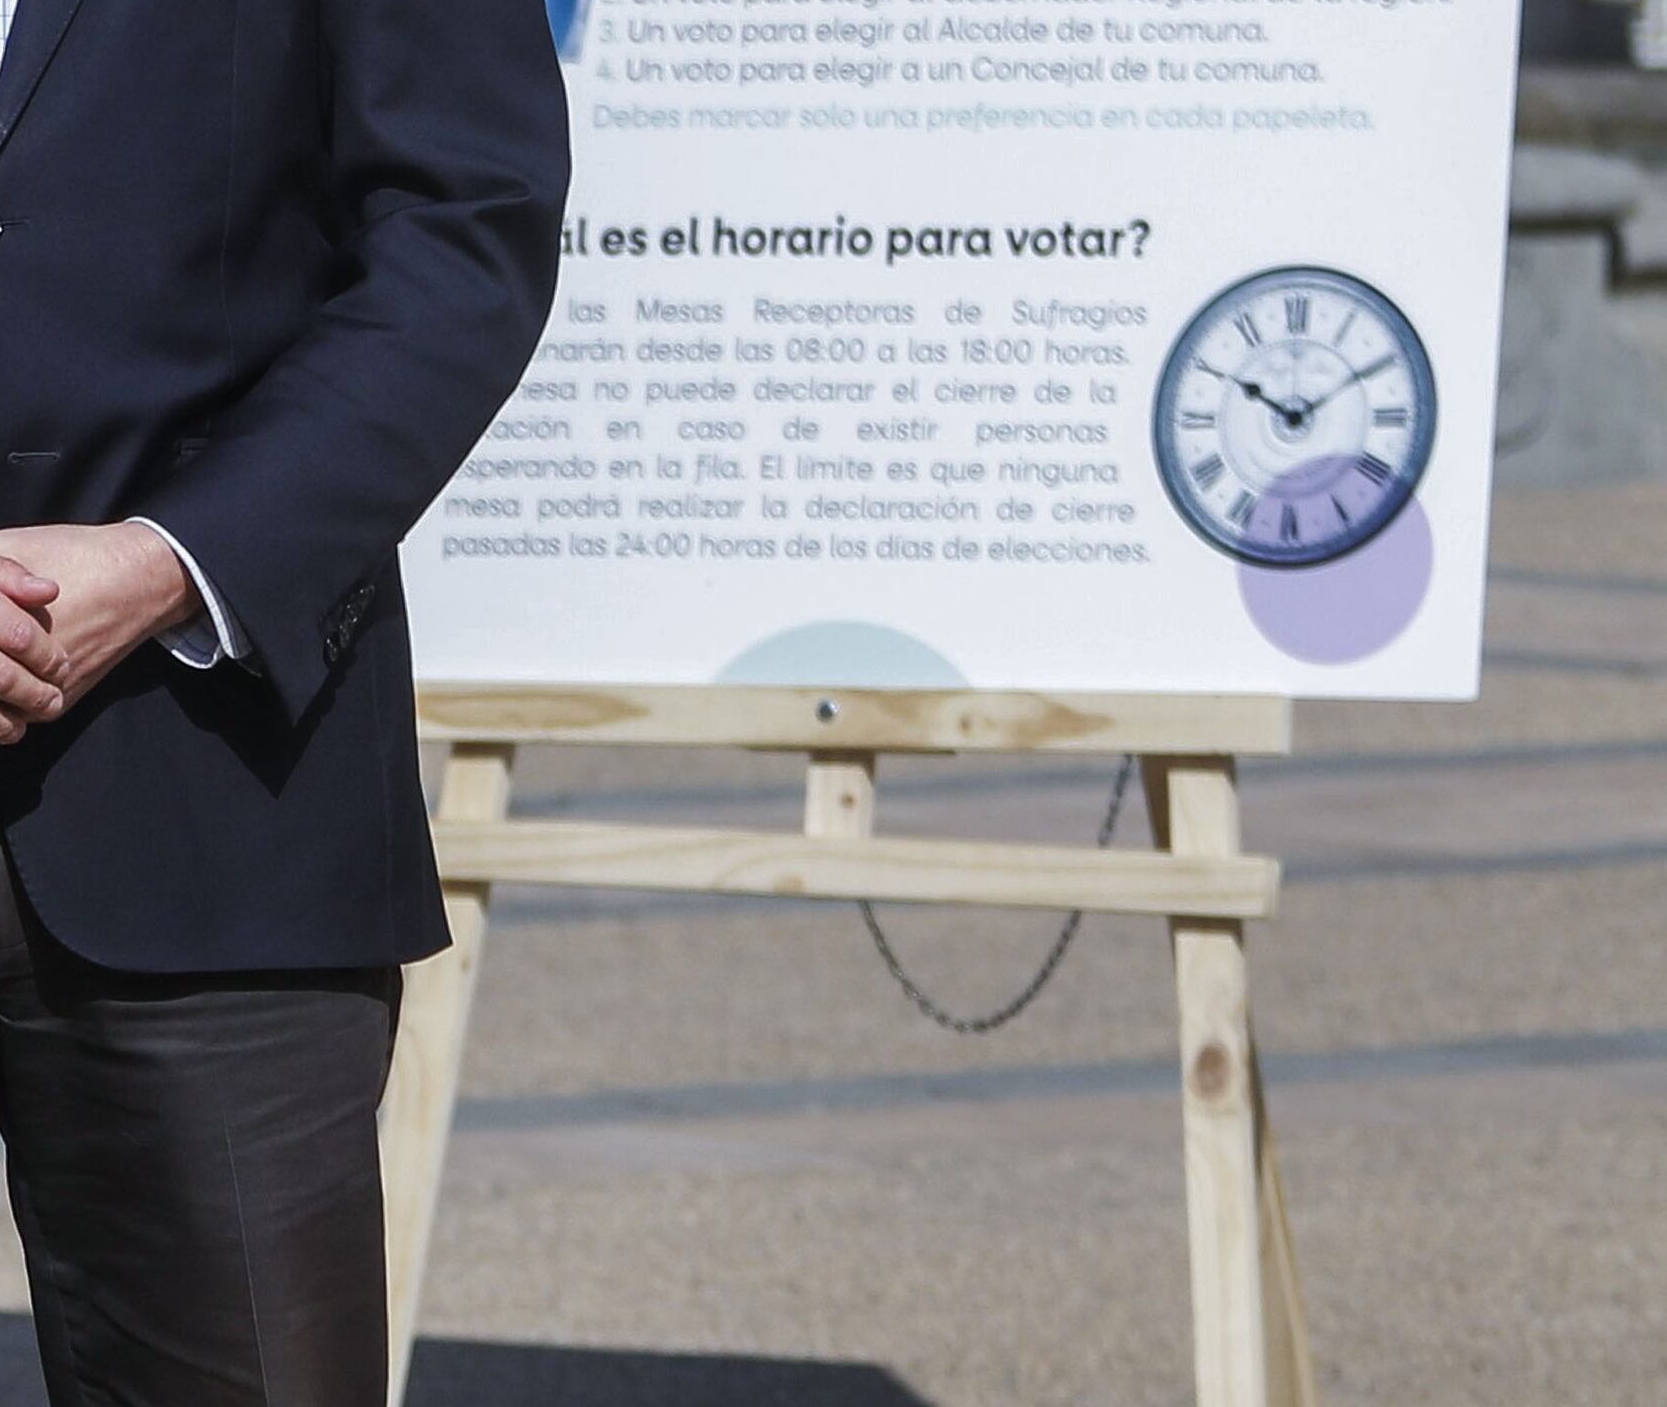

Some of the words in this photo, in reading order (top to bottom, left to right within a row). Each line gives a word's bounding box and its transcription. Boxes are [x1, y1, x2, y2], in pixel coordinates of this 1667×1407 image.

[599, 227, 649, 256] es
[659, 217, 700, 256] el
[711, 216, 874, 256] horario
[885, 228, 993, 265] para
[1005, 219, 1151, 257] votar?
